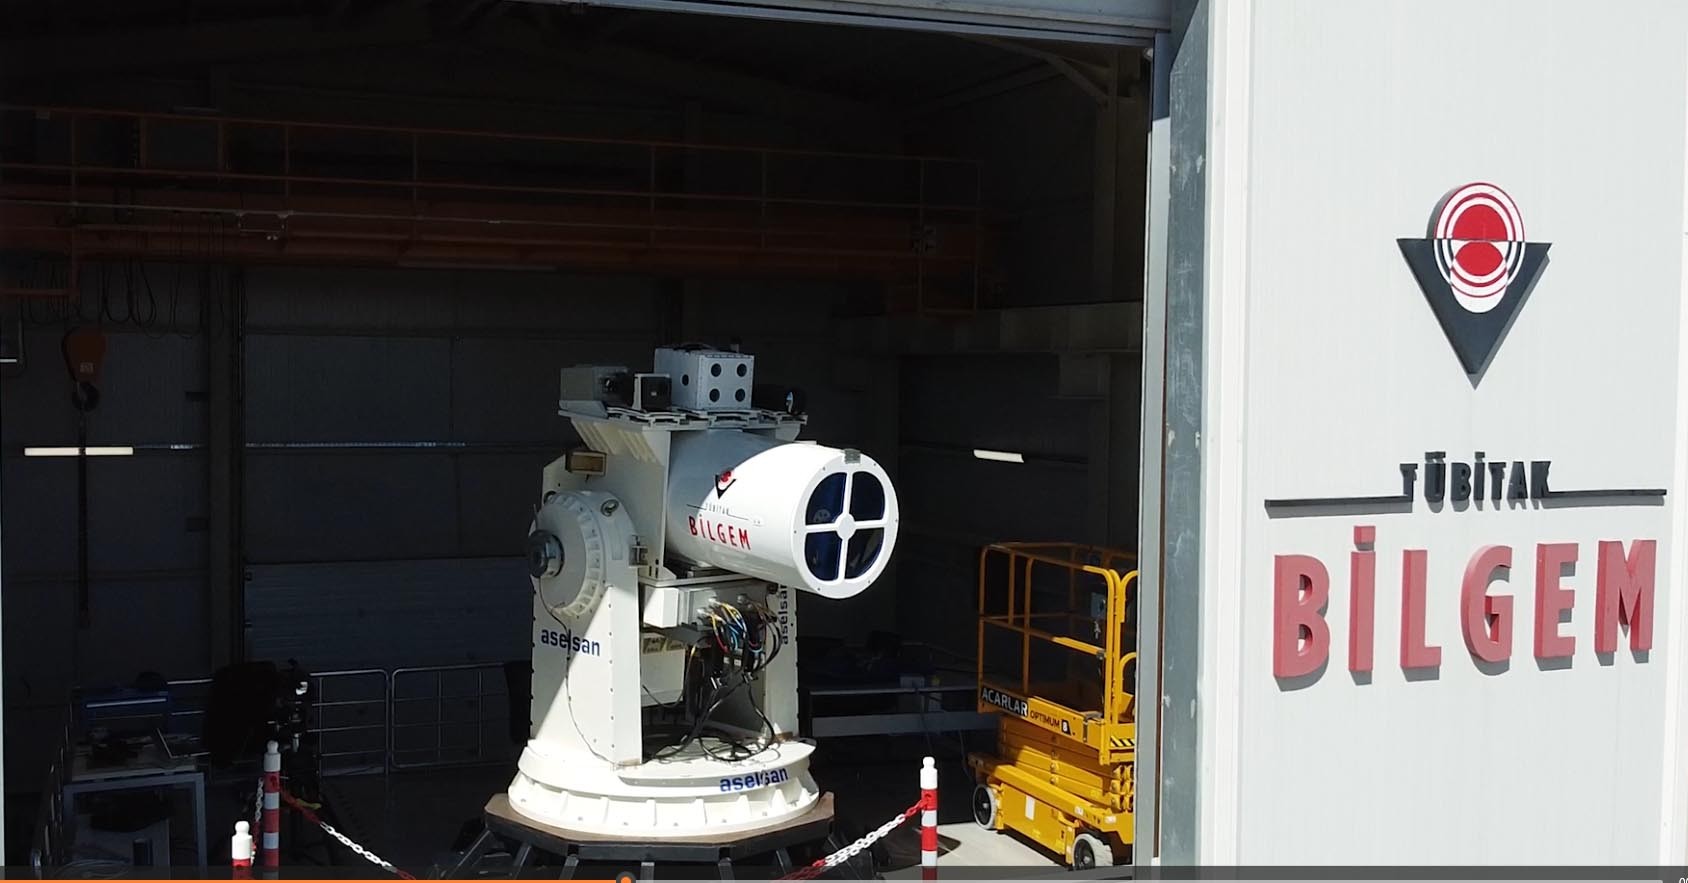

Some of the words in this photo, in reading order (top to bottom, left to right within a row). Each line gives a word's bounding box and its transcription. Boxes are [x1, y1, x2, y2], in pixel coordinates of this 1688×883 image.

[1399, 451, 1552, 505] TÜBİTAK
[688, 514, 751, 550] BİLGEM
[1273, 525, 1657, 680] BİLGEM
[540, 629, 600, 656] aselsan
[982, 687, 1028, 717] ACARLAR
[1030, 710, 1060, 729] OPTIMUM
[720, 767, 789, 792] aselsan
